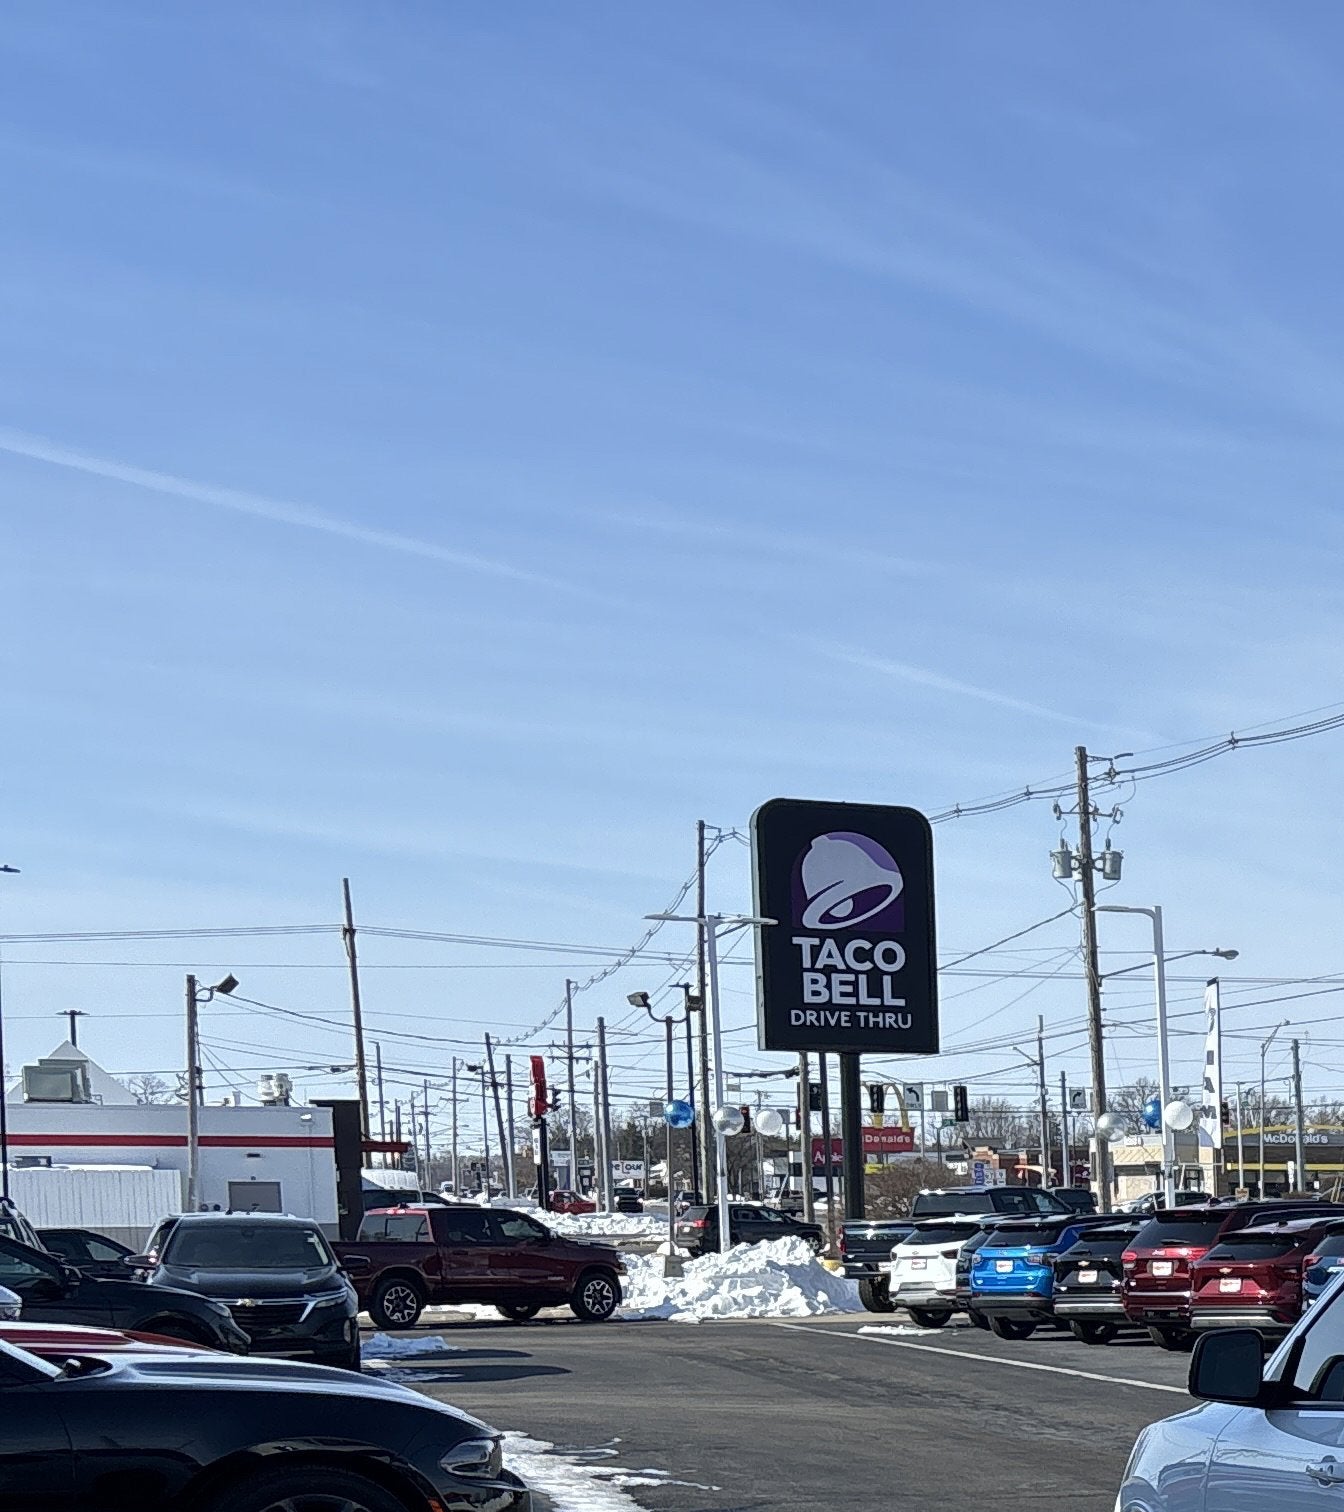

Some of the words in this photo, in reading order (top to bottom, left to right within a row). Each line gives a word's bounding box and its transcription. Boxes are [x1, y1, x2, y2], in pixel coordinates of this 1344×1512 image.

[792, 936, 906, 972] TACO
[802, 971, 906, 1007] BELL
[790, 1009, 852, 1028] DRIVE
[855, 1011, 912, 1029] THRU
